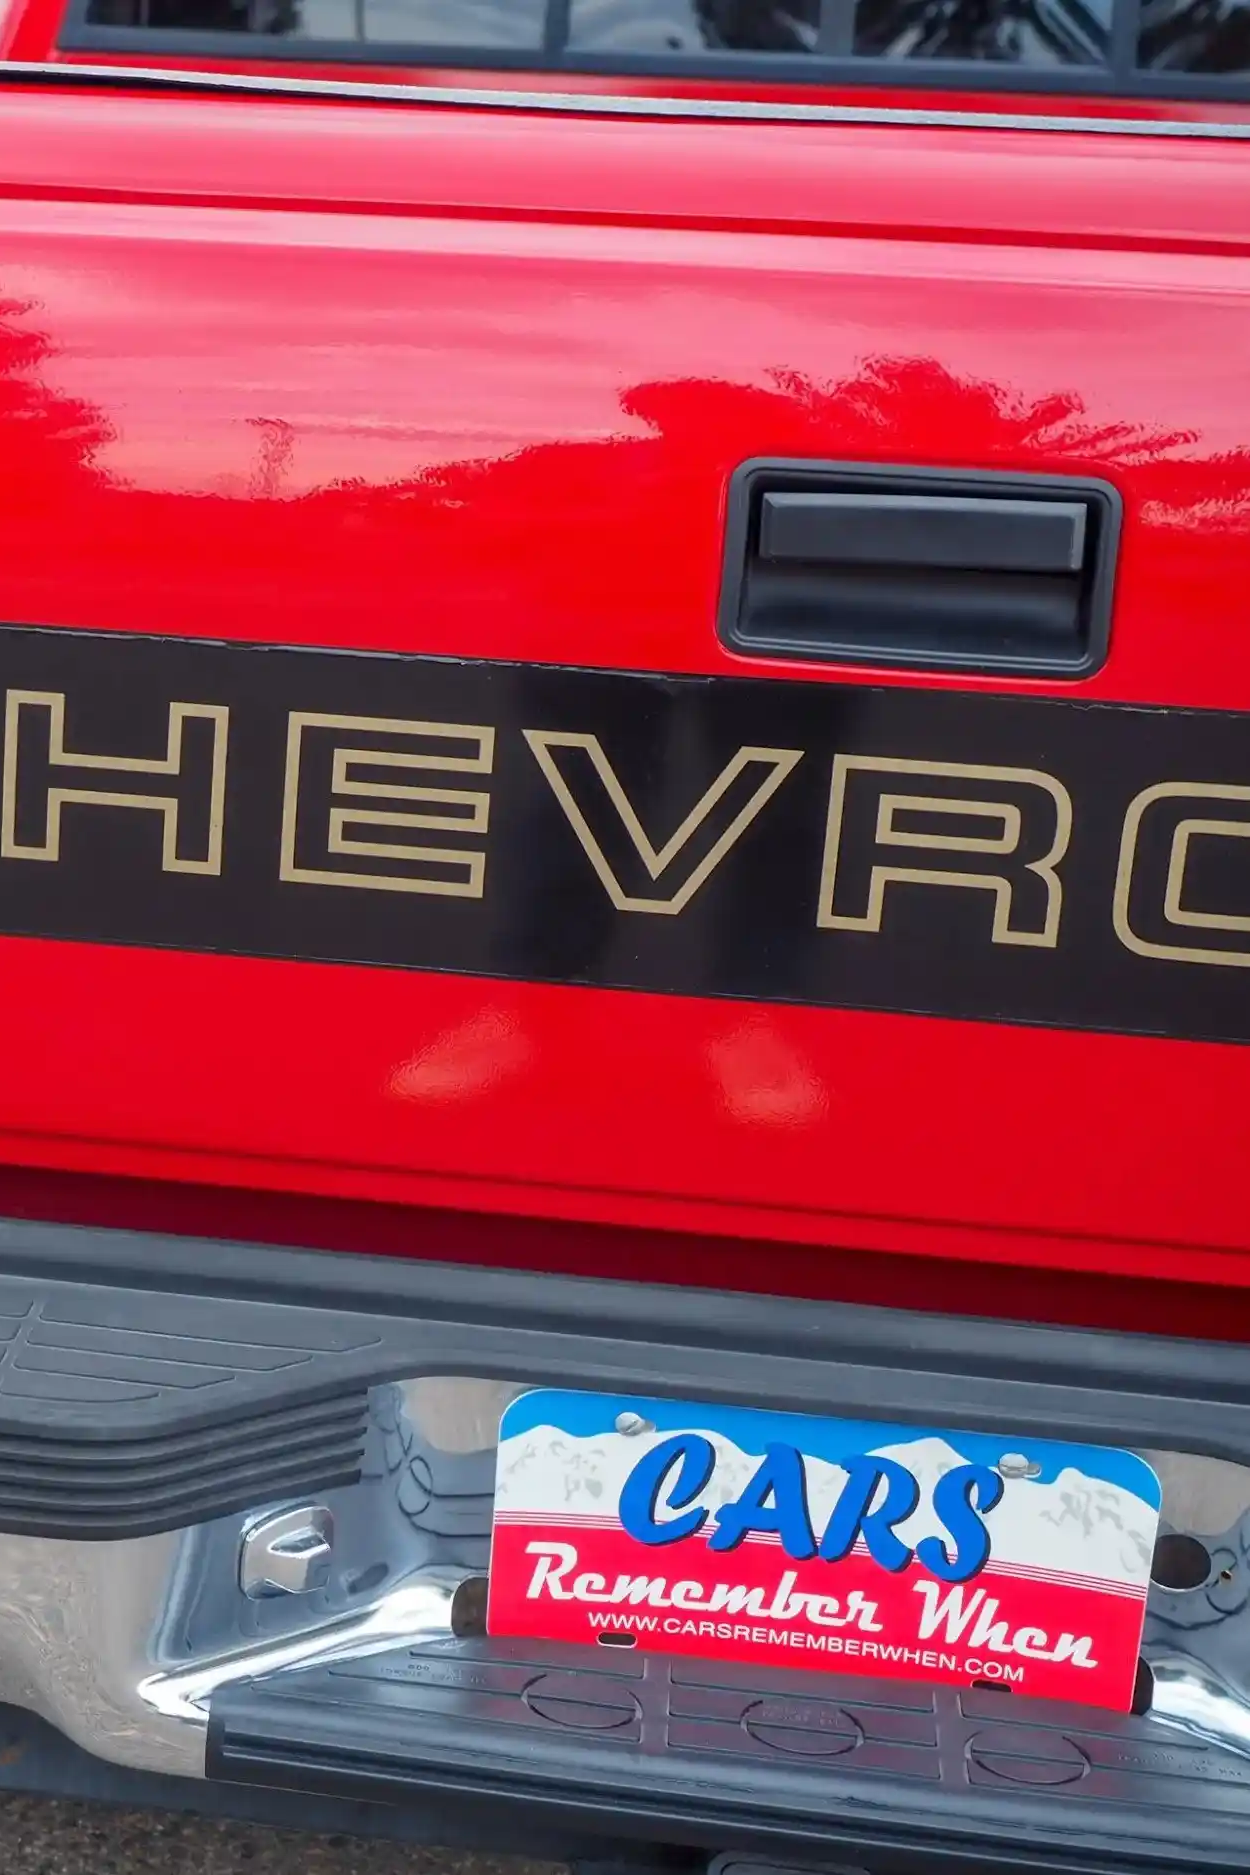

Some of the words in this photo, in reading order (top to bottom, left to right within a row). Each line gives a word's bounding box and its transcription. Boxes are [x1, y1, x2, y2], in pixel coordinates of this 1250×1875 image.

[617, 1432, 1006, 1583] CARS
[524, 1540, 884, 1633] Remember
[911, 1578, 1099, 1670] When
[587, 1611, 1025, 1682] WWW.CARSREMEMBERWHEN.COM
